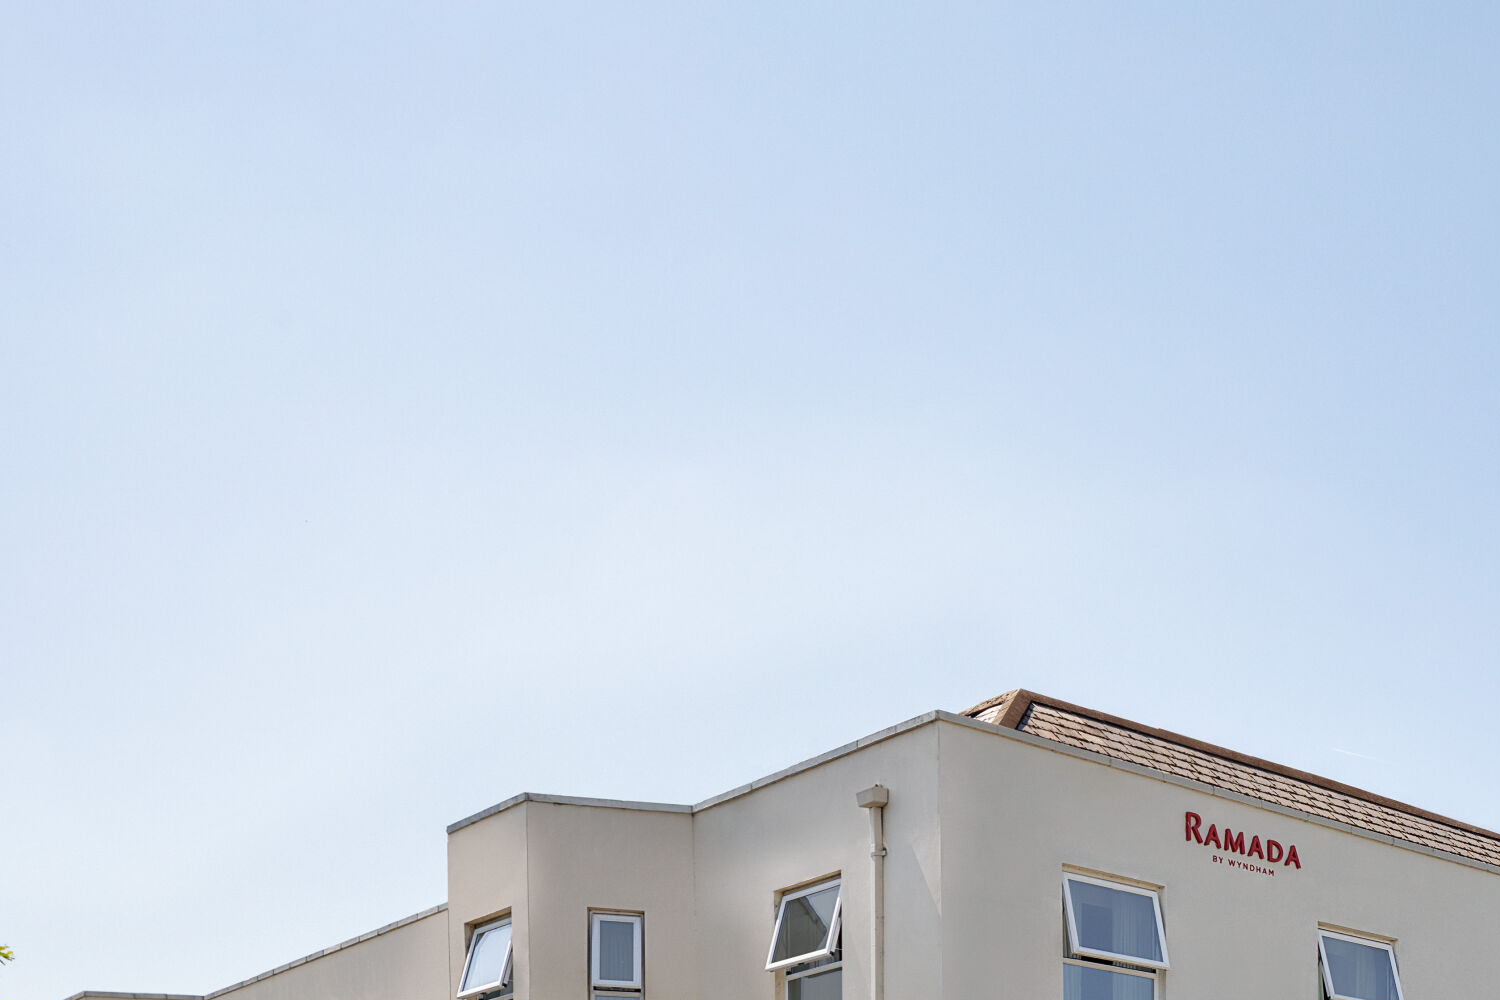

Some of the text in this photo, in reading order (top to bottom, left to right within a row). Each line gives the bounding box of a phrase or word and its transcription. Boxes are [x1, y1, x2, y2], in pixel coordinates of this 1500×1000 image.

[1185, 811, 1301, 869] RAMADA
[1212, 855, 1275, 877] BY WYNDHAM
